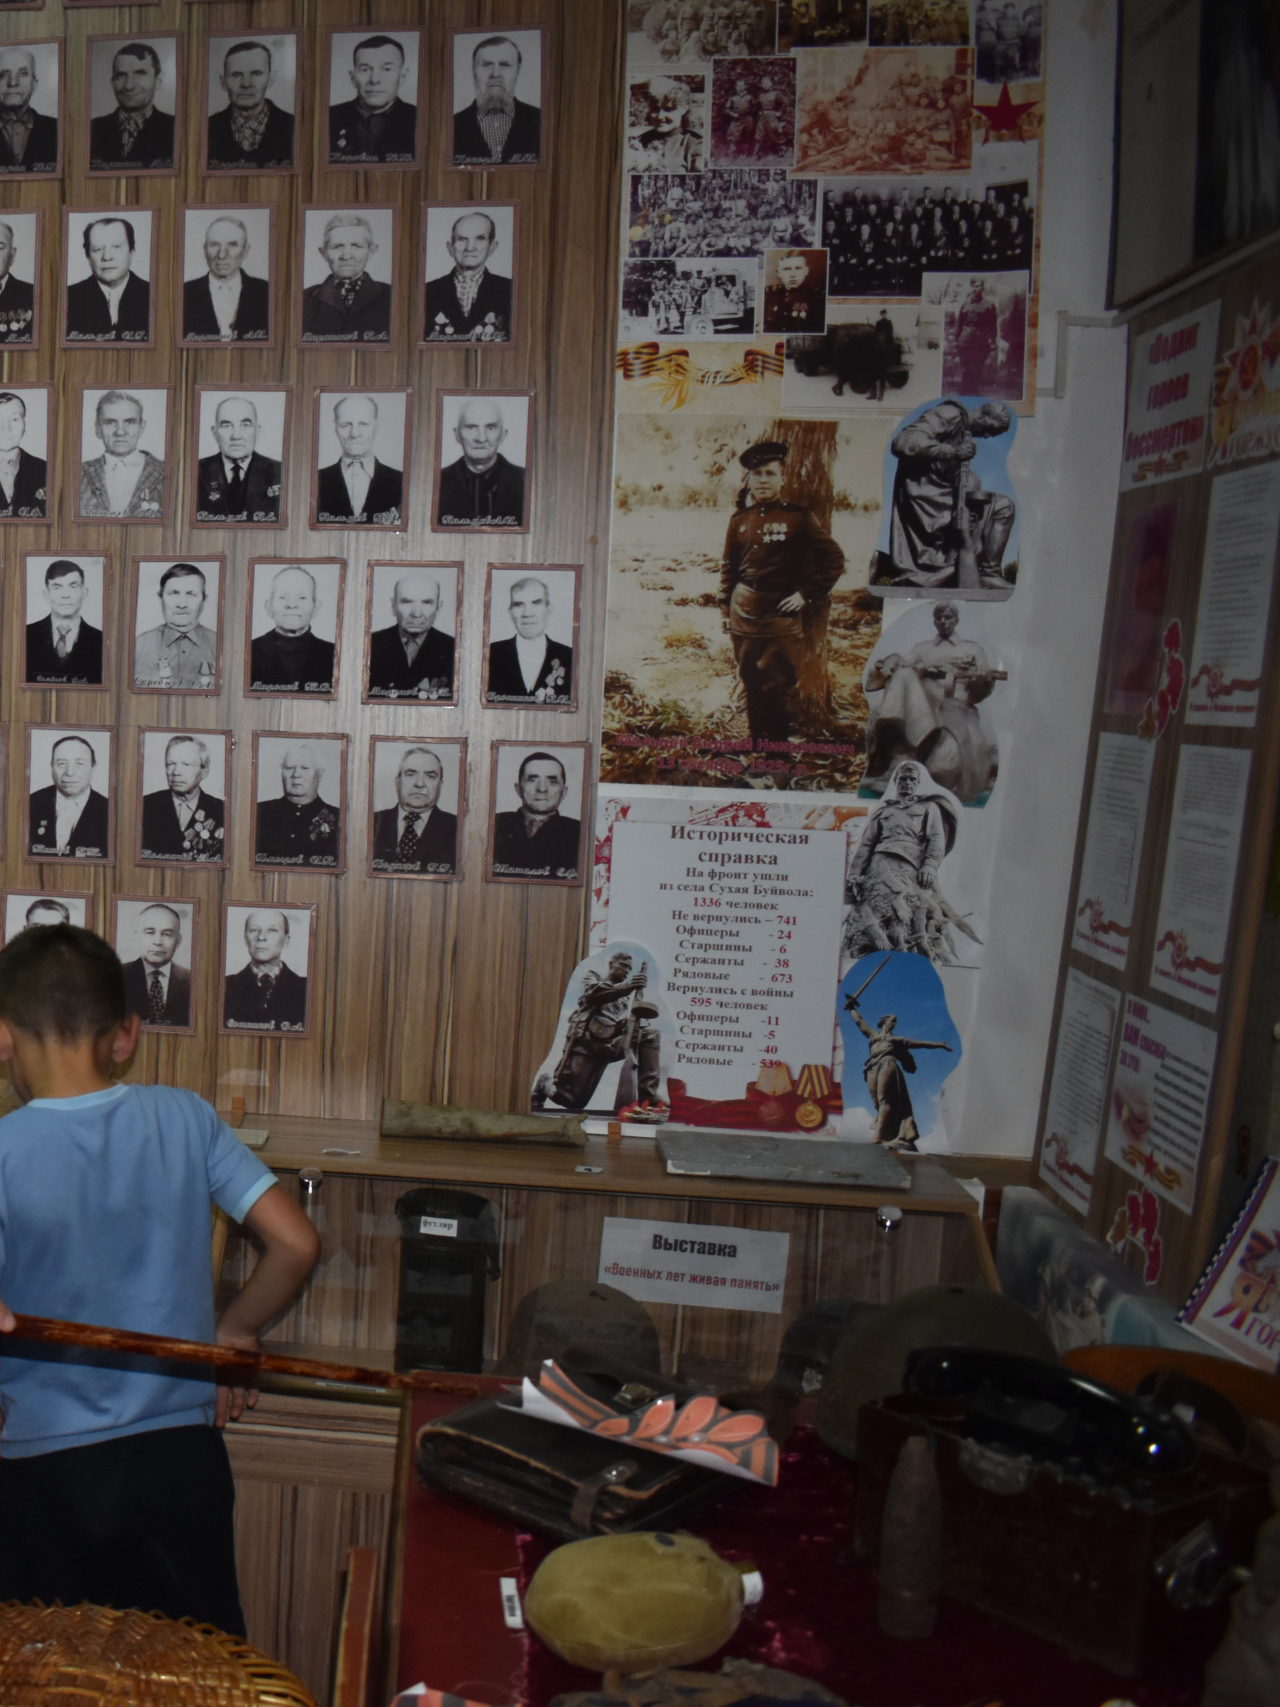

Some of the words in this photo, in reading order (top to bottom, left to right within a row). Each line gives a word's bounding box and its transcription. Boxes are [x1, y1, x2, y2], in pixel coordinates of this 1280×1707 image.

[671, 825, 809, 845] Историческая
[698, 852, 778, 867] справка
[686, 867, 704, 878] На
[708, 868, 749, 881] фронт
[752, 873, 789, 882] ушли
[659, 882, 673, 890] из
[677, 884, 705, 892] села
[709, 883, 749, 896] Сухая
[693, 897, 722, 908] 1336
[725, 901, 779, 911] человек
[671, 910, 689, 921] Не
[693, 914, 761, 925] вернулись
[776, 915, 797, 926] 741
[675, 925, 740, 939] Офицеры
[777, 930, 792, 940] 24
[679, 939, 752, 953] Старшины
[779, 944, 787, 954] 6
[674, 953, 744, 966] Сержанты
[774, 959, 790, 969] 38
[673, 968, 731, 980] Рядовые
[771, 973, 793, 984] 673
[666, 982, 737, 996] Вернулись
[741, 988, 747, 996] с
[751, 988, 794, 998] войны
[690, 997, 712, 1007] 595
[716, 1000, 769, 1011] человек
[676, 1010, 739, 1025] Офицеры
[680, 1025, 752, 1038] Старшины
[675, 1039, 744, 1053] Сержанты
[677, 1053, 733, 1066] Рядовые
[652, 1234, 737, 1258] Выставка
[604, 1262, 663, 1280] «Военных
[665, 1271, 686, 1282] лет
[688, 1273, 727, 1286] живая
[730, 1278, 780, 1292] память»
